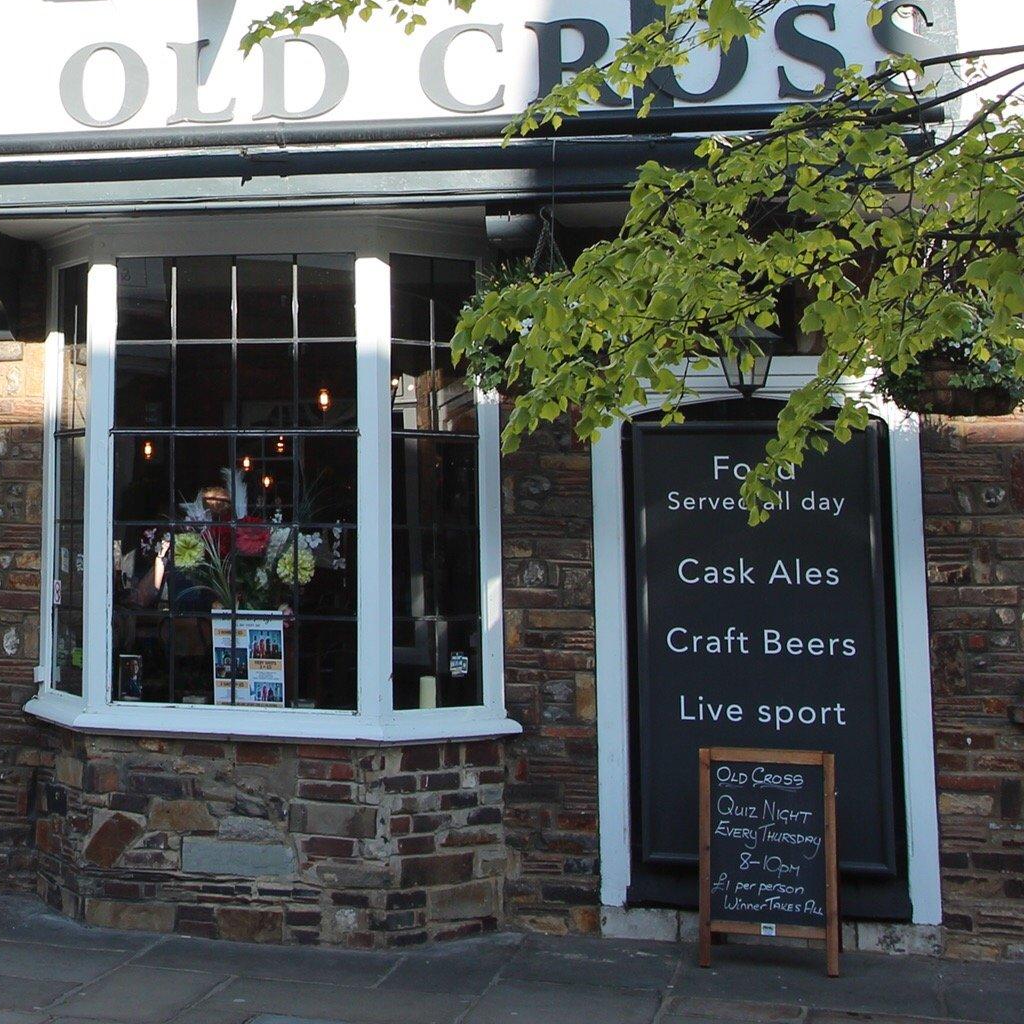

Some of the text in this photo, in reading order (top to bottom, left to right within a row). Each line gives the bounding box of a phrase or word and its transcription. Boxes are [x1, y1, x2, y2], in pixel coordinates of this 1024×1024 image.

[59, 33, 349, 128] OLD
[801, 491, 845, 516] day
[677, 558, 840, 586] Cask Ales
[666, 627, 856, 657] Craft Beers
[679, 695, 846, 730] Live sport
[716, 766, 804, 787] OLD CROSS
[762, 799, 813, 824] NIGHT
[711, 872, 805, 896] £1 per person
[723, 895, 767, 912] Winner
